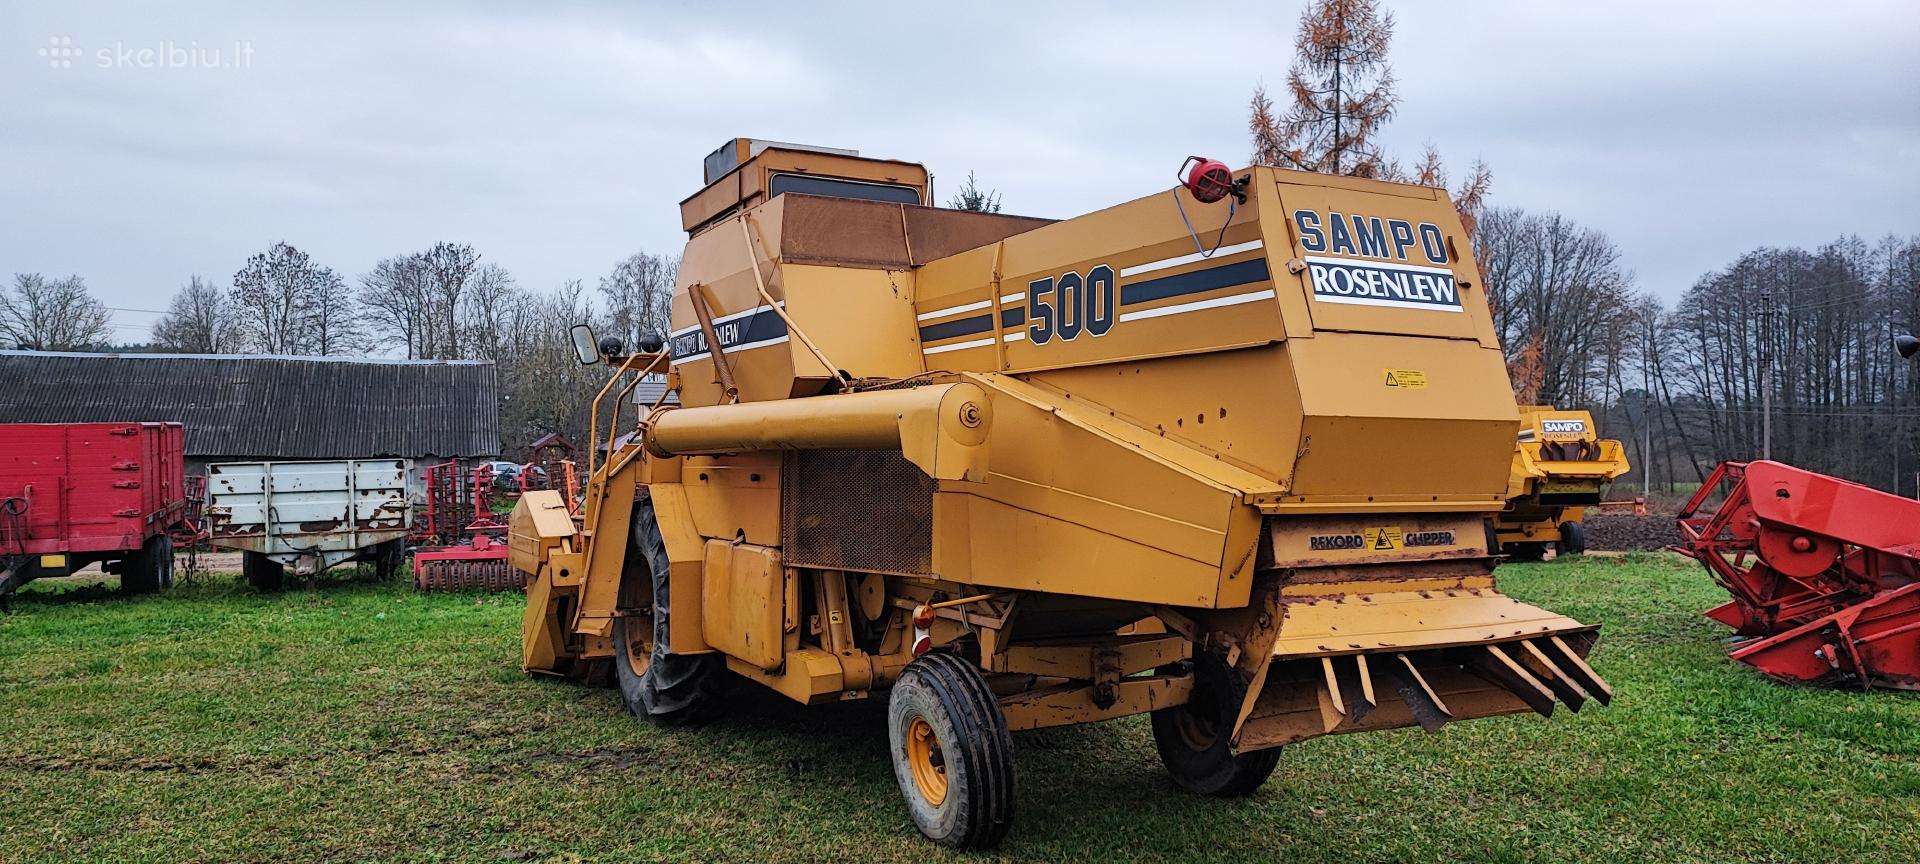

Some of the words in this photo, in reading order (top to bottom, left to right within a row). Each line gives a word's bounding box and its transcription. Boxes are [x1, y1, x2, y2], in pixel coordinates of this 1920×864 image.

[1293, 209, 1449, 265] SAMPO
[1309, 265, 1454, 303] ROSENLEW
[1028, 264, 1115, 346] 500
[1544, 422, 1583, 432] SAMPO
[1310, 535, 1363, 550] REKORD
[1406, 531, 1454, 546] CLIPPER
